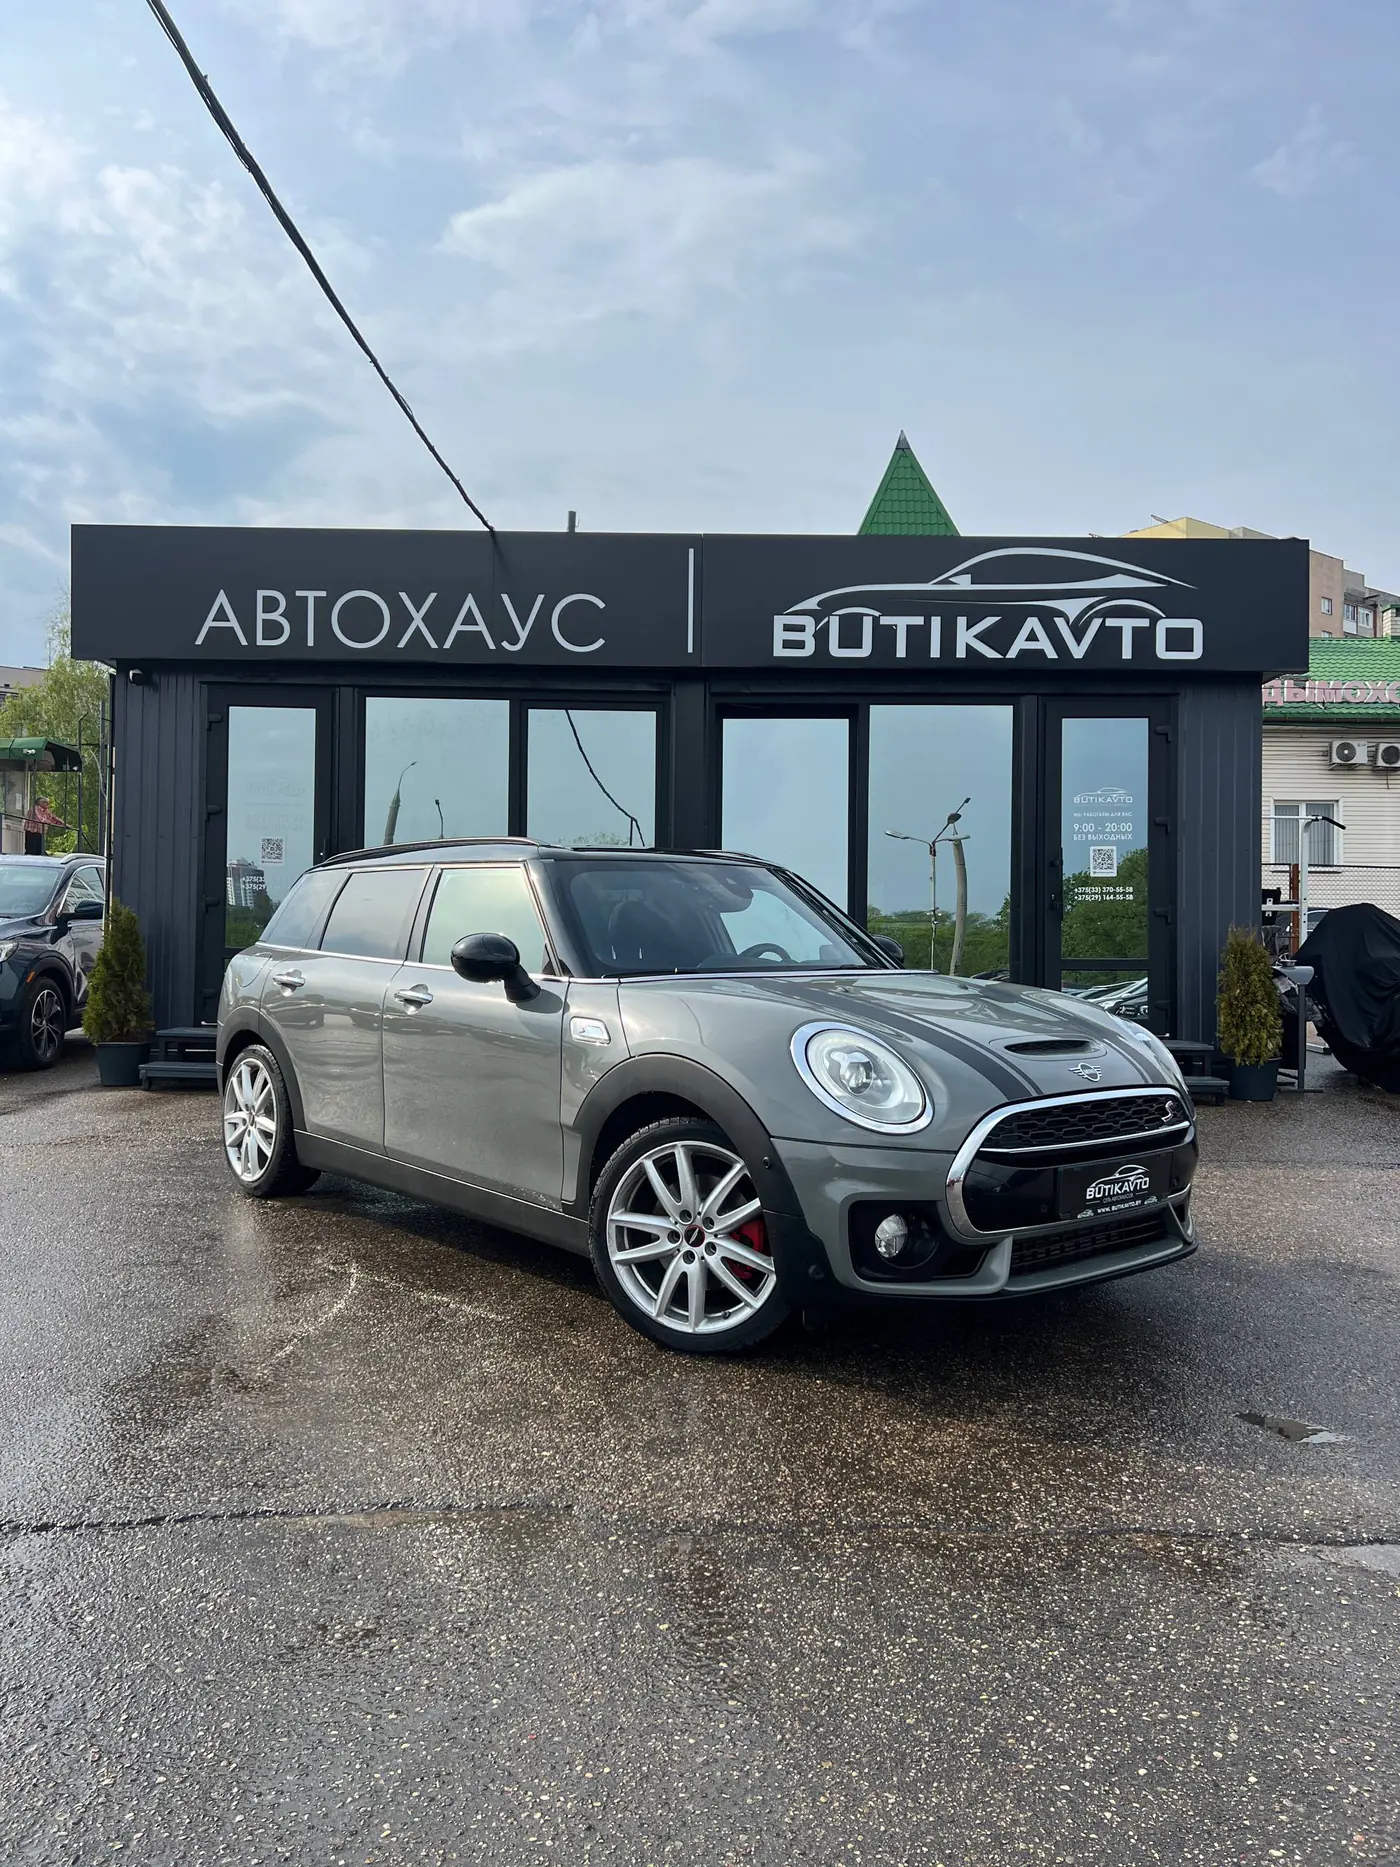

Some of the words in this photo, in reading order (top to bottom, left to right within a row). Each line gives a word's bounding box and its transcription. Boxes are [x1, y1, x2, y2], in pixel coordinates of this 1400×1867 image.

[195, 589, 606, 652] АВТОХАУС
[773, 615, 1203, 660] BUTIKAVTO
[1073, 823, 1095, 832] 9:00
[1105, 823, 1133, 832] 20:00
[1087, 833, 1133, 841] ВЫХОДНЫХ
[1161, 1100, 1173, 1122] S
[1086, 1177, 1150, 1199] BUTIKAVTO
